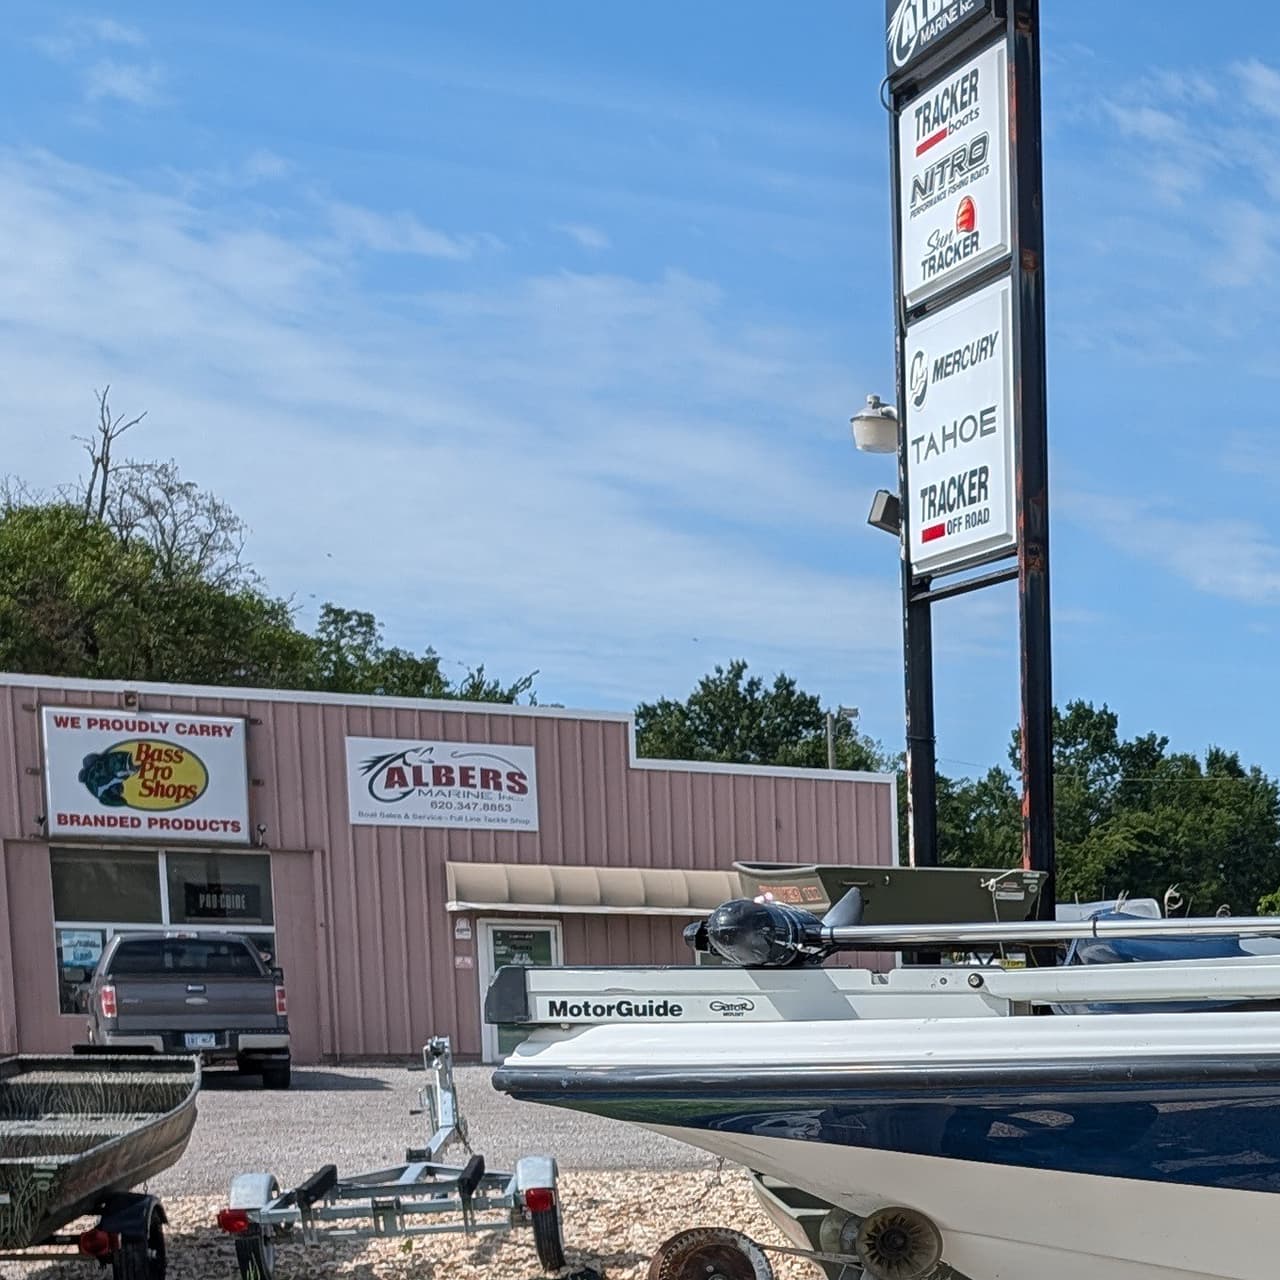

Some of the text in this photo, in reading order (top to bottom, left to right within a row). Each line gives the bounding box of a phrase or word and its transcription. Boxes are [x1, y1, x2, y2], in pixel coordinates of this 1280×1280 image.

[920, 4, 958, 46] MARINE
[915, 68, 979, 141] TRACKER
[948, 107, 980, 136] boats
[910, 131, 989, 209] NITRO
[921, 230, 979, 281] TRACKER
[932, 331, 999, 384] MERCURY
[911, 405, 998, 464] TAHOE
[920, 465, 989, 523] TRACKER
[947, 507, 990, 535] OFF ROAD
[54, 715, 234, 738] WE PROUDLY CARRY
[135, 743, 185, 764] Bass
[138, 761, 173, 781] Pro
[384, 765, 529, 795] ALBERS
[138, 779, 198, 803] Shops
[418, 788, 493, 801] MARINE
[57, 813, 242, 833] BRANDED PRODUCTS
[549, 1000, 683, 1017] MotorGuide
